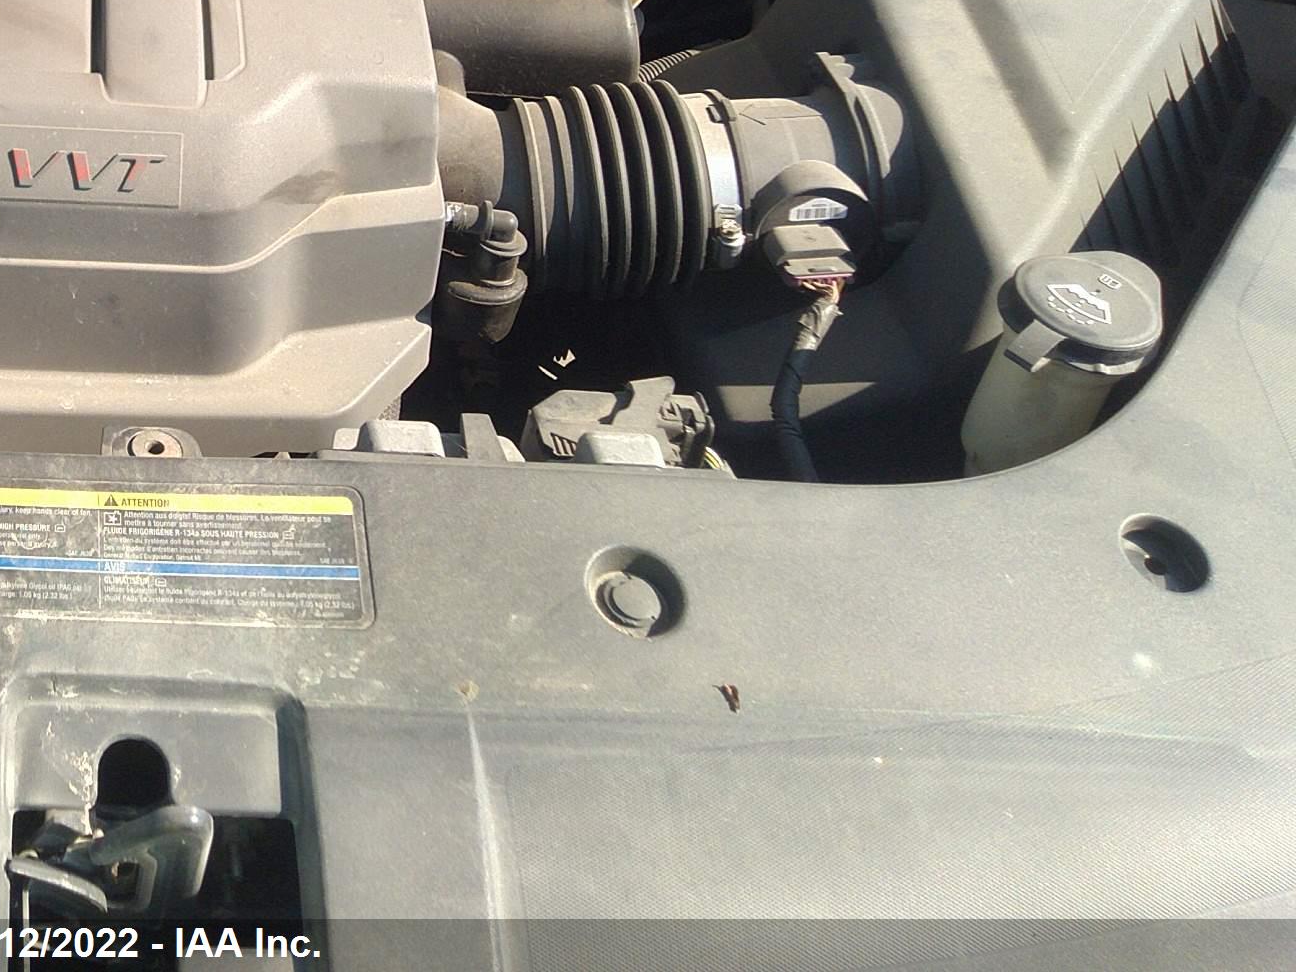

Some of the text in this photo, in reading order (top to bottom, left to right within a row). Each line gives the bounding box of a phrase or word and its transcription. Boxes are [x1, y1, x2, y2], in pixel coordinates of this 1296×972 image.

[7, 147, 168, 194] VVT
[121, 498, 170, 508] ATTENTION
[15, 523, 51, 532] PRESSURE
[201, 529, 220, 538] SOUS
[220, 530, 244, 539] HAUTE
[244, 531, 280, 540] PRESSION
[104, 561, 126, 572] AVIS
